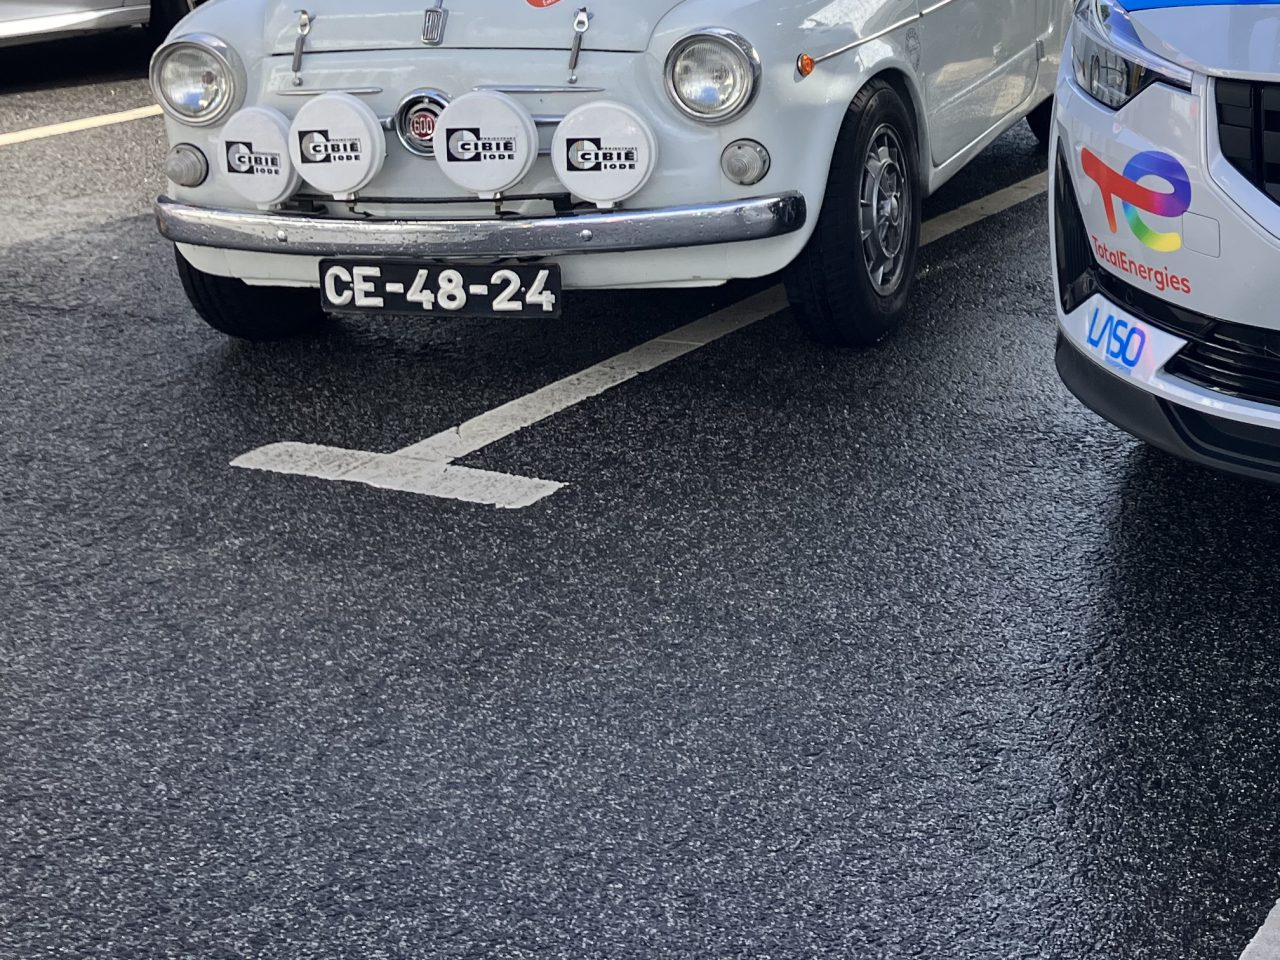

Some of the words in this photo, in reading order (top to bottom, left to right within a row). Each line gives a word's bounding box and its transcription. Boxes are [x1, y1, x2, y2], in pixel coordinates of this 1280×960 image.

[413, 117, 433, 135] 600
[256, 167, 280, 175] IODE
[1091, 235, 1192, 295] TotalEnergies
[324, 265, 556, 312] CE-48-24
